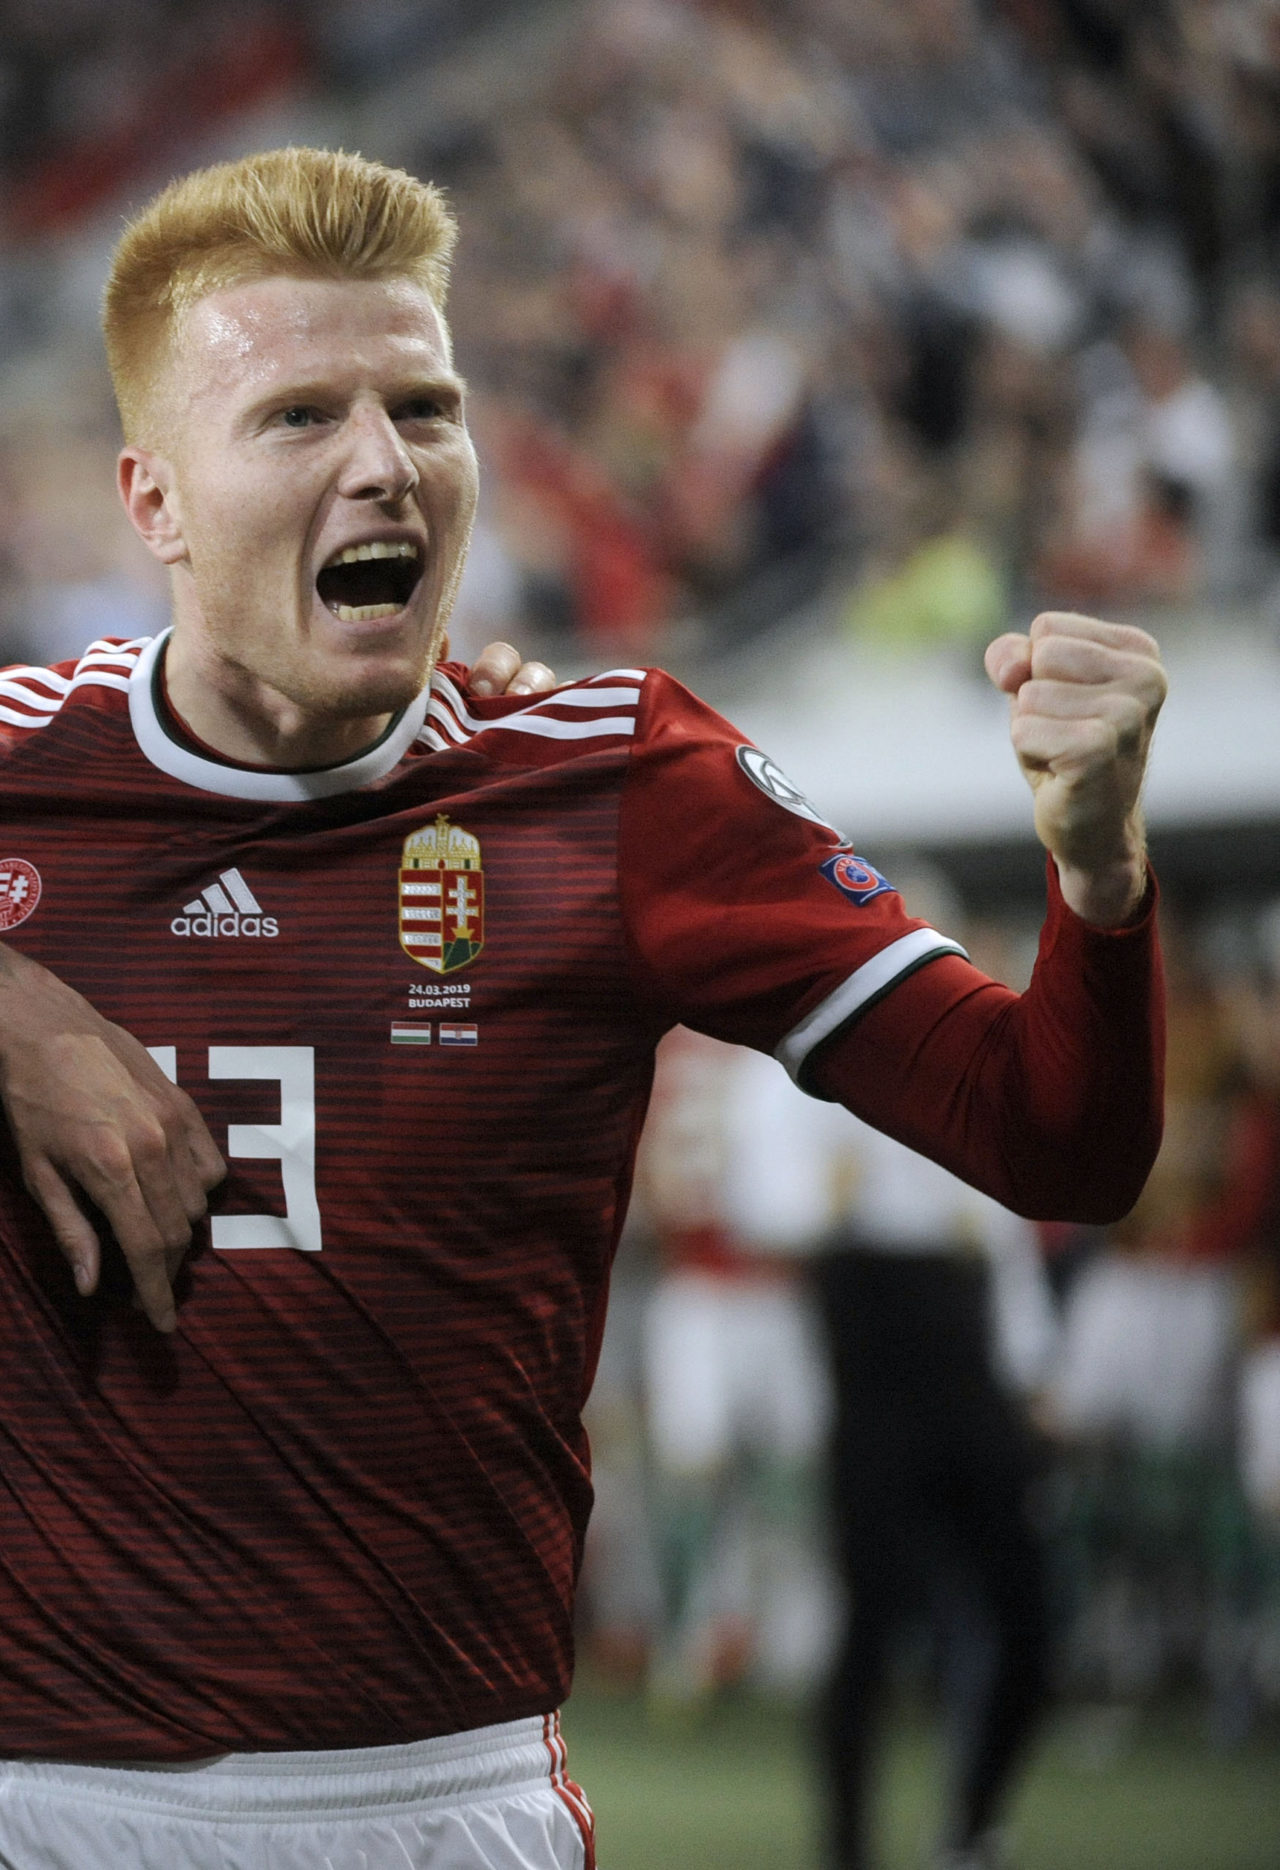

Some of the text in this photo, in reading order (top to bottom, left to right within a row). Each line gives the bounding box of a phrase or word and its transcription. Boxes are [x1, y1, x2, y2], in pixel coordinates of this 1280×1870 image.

[170, 912, 280, 938] adidas
[408, 984, 471, 996] 24.03.2019
[408, 998, 471, 1008] BUDAPEST
[146, 1046, 322, 1251] 3
